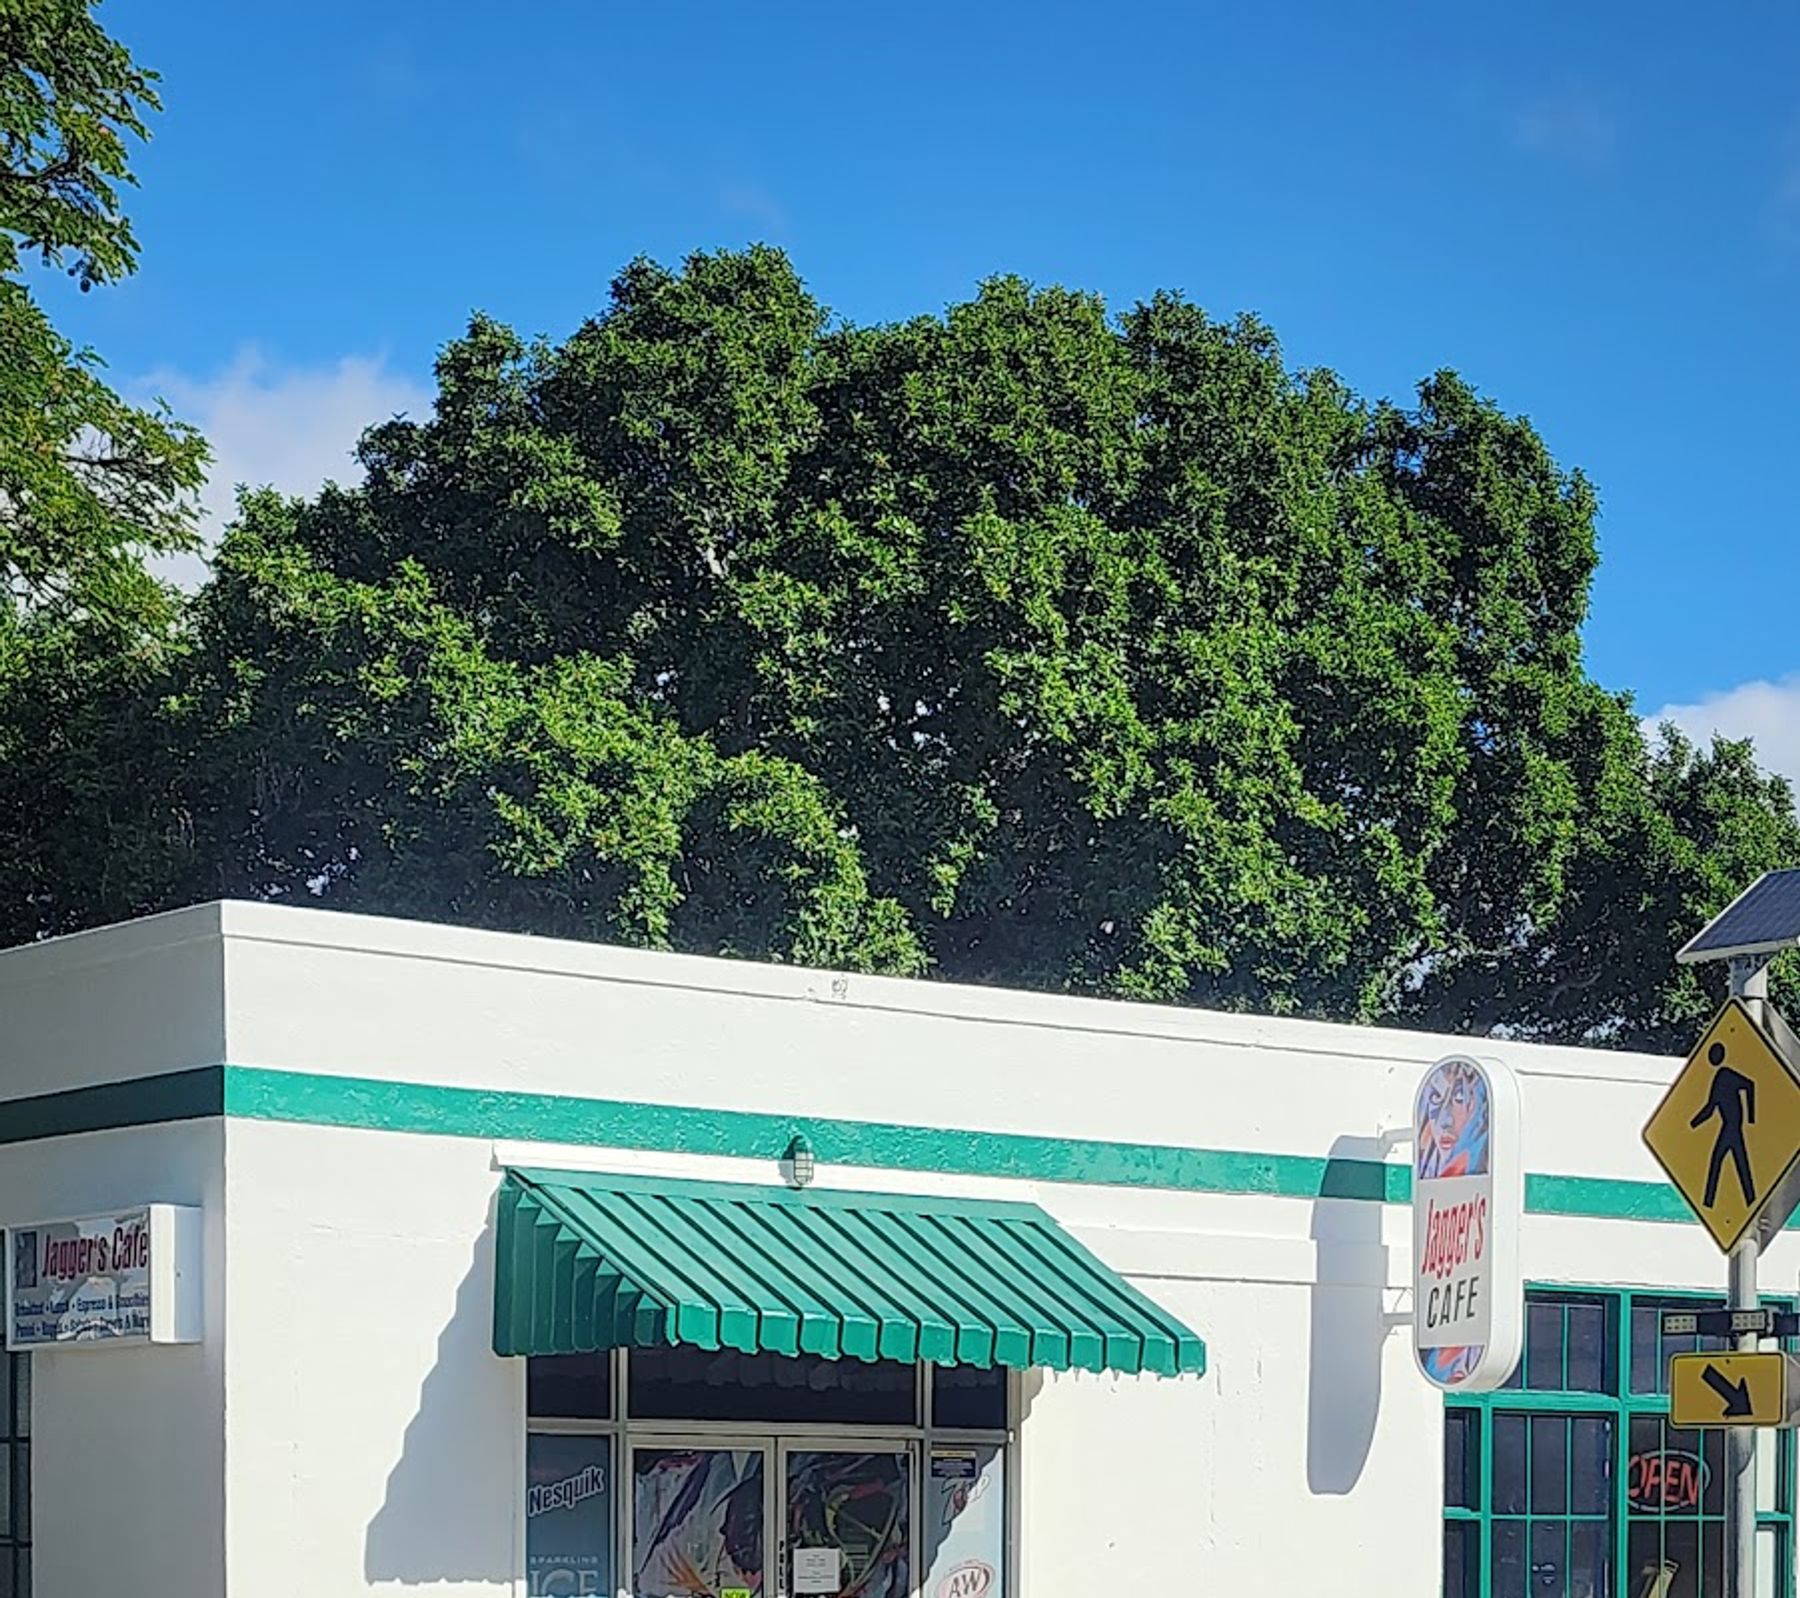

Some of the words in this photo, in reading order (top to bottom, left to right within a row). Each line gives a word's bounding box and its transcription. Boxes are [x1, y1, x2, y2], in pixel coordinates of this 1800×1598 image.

[41, 1233, 108, 1280] Jagger's
[1421, 1192, 1486, 1279] Jagger's
[1426, 1276, 1479, 1328] CAFE
[528, 1465, 605, 1518] Nesquik
[1628, 1454, 1700, 1506] OPEN
